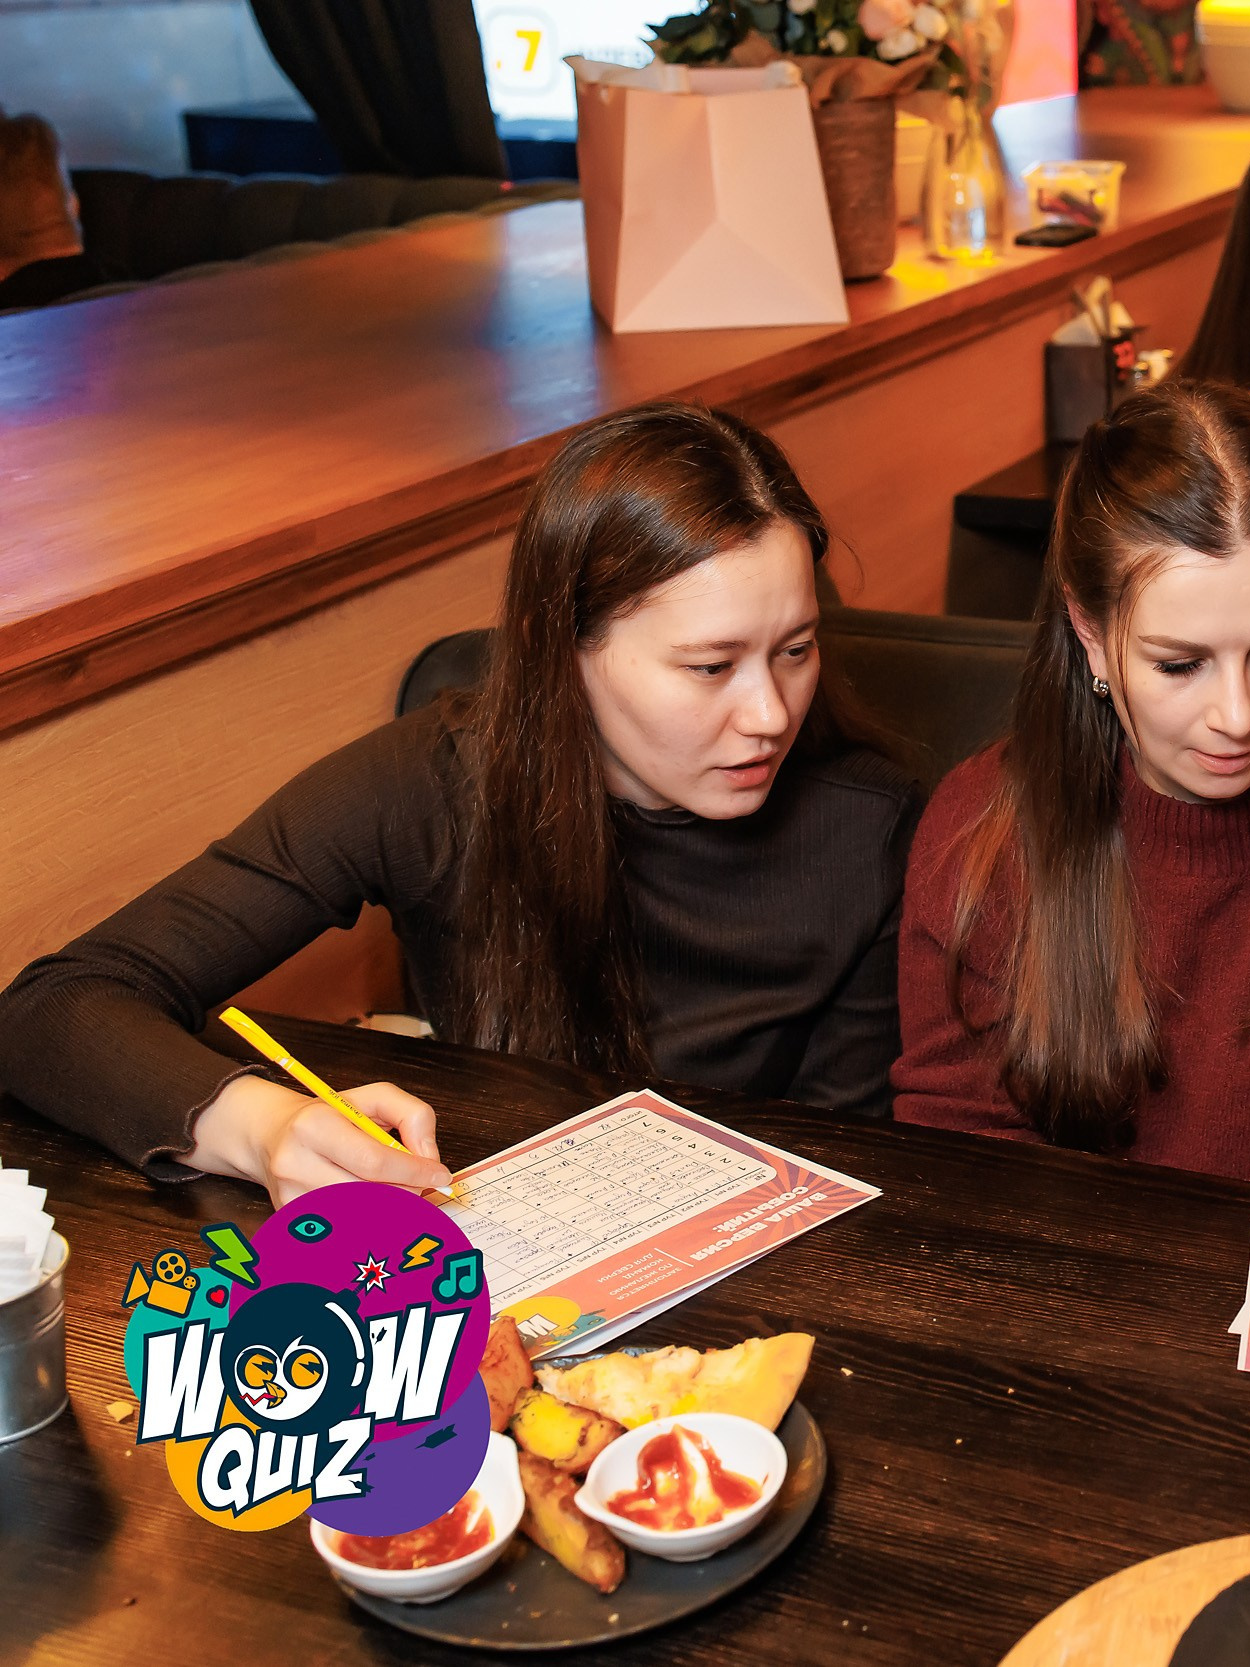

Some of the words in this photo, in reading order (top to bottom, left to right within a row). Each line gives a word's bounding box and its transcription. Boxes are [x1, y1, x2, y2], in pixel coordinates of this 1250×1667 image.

[516, 30, 541, 71] 7
[713, 1186, 809, 1232] СОБЫТИЙ:
[763, 1192, 828, 1222] ВАША
[689, 1221, 768, 1261] ВЕРСИЯ
[622, 1258, 664, 1280] КОМАНД
[634, 1253, 653, 1265] ДЛЯ
[659, 1263, 673, 1271] ПО
[597, 1264, 634, 1283] СВЕРКИ
[609, 1271, 658, 1296] ЖЕЛАНИЮ
[616, 1267, 682, 1301] ЗАПОЛНЯЕТСЯ
